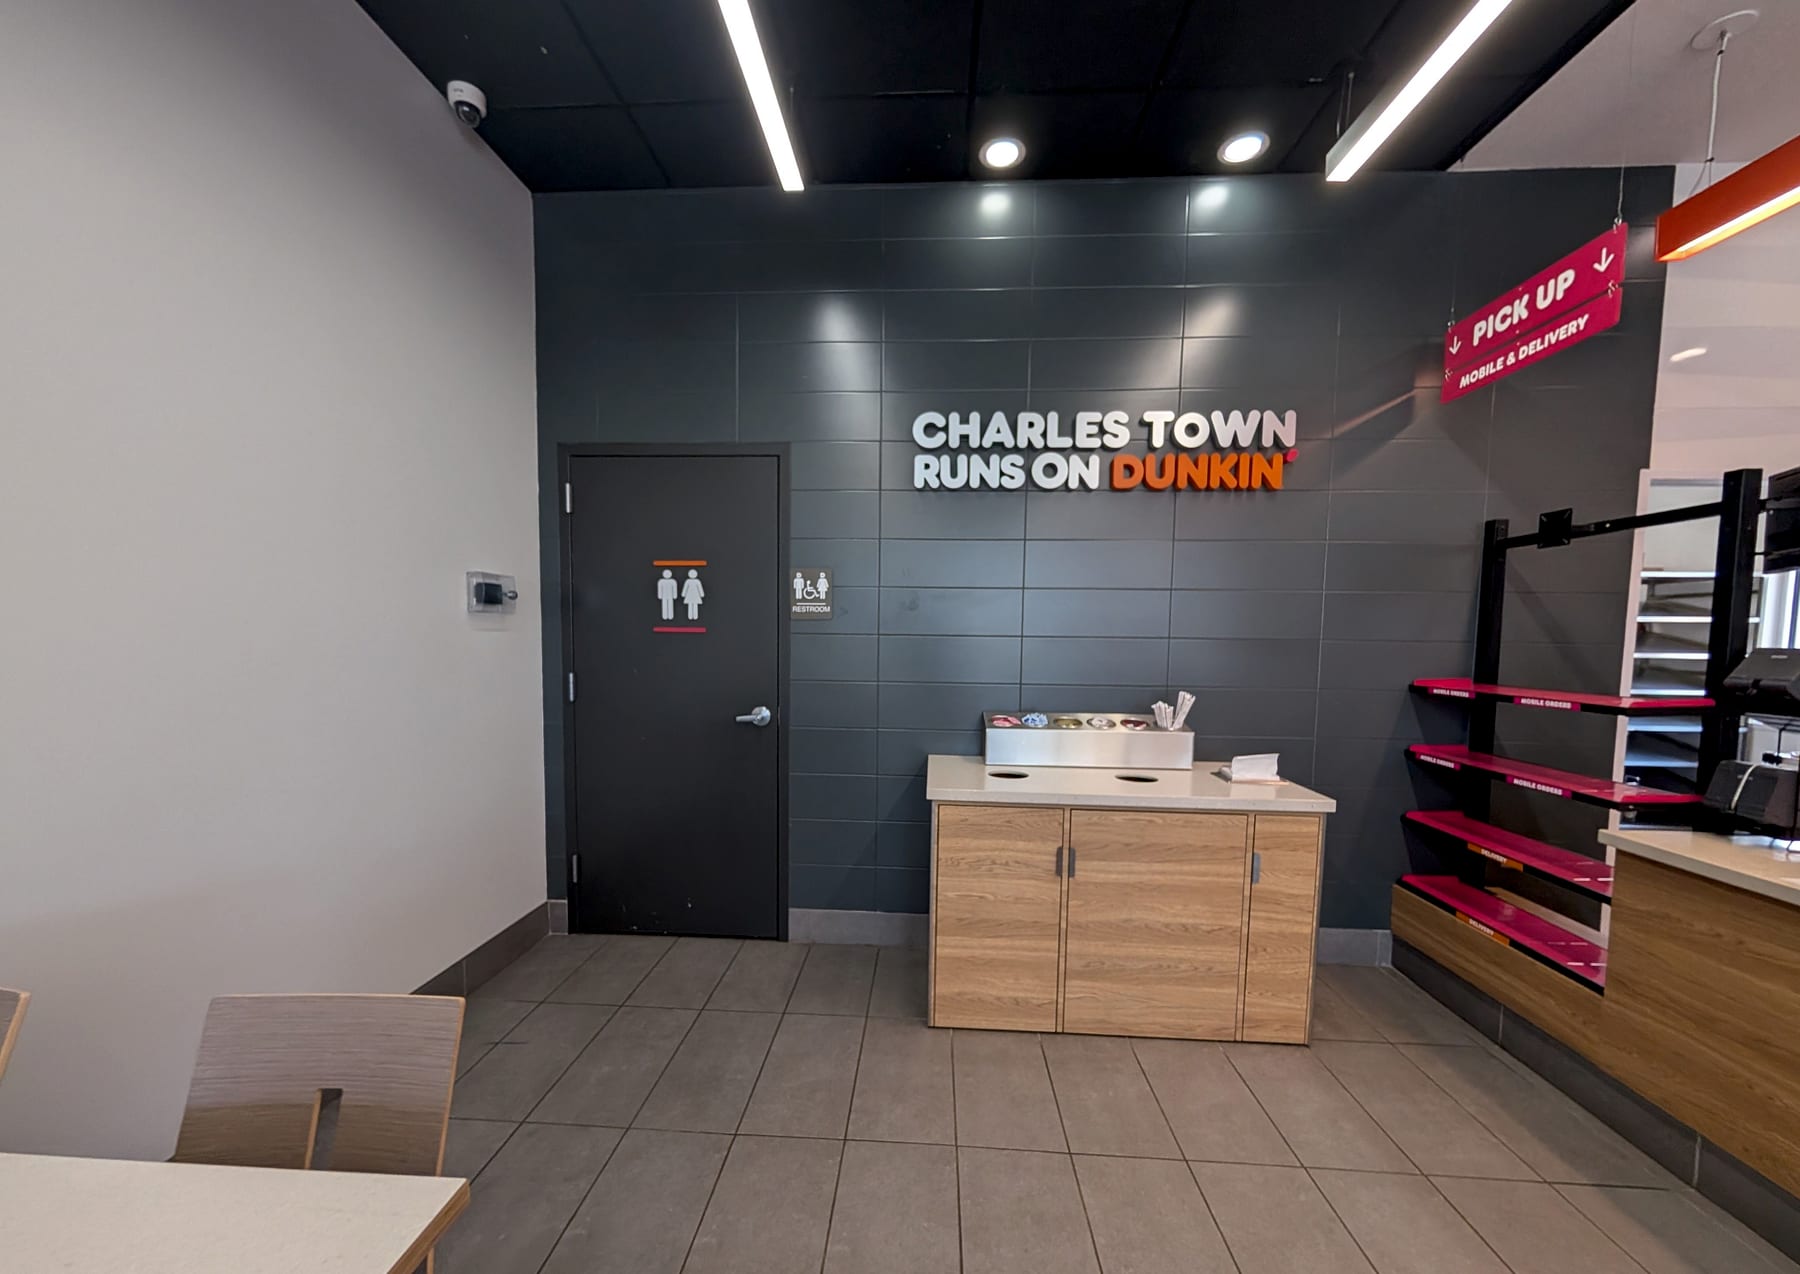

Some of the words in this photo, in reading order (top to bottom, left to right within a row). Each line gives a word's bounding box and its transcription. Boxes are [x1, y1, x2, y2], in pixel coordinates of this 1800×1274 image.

[1472, 294, 1529, 346] PICK
[1535, 269, 1576, 310] UP
[1459, 357, 1504, 388] MOBILE
[1506, 352, 1516, 366] &
[1518, 314, 1590, 360] DELIVERY
[912, 410, 1131, 449] CHARLES
[1141, 409, 1298, 449] TOWN
[914, 453, 1026, 489] RUNS
[1031, 452, 1100, 489] ON
[1111, 449, 1299, 491] DUNKIN'
[792, 605, 831, 613] RESTROOM
[1521, 698, 1544, 707] MOBILE
[1545, 700, 1572, 709] ORDERS
[1513, 778, 1536, 790] MOBILE
